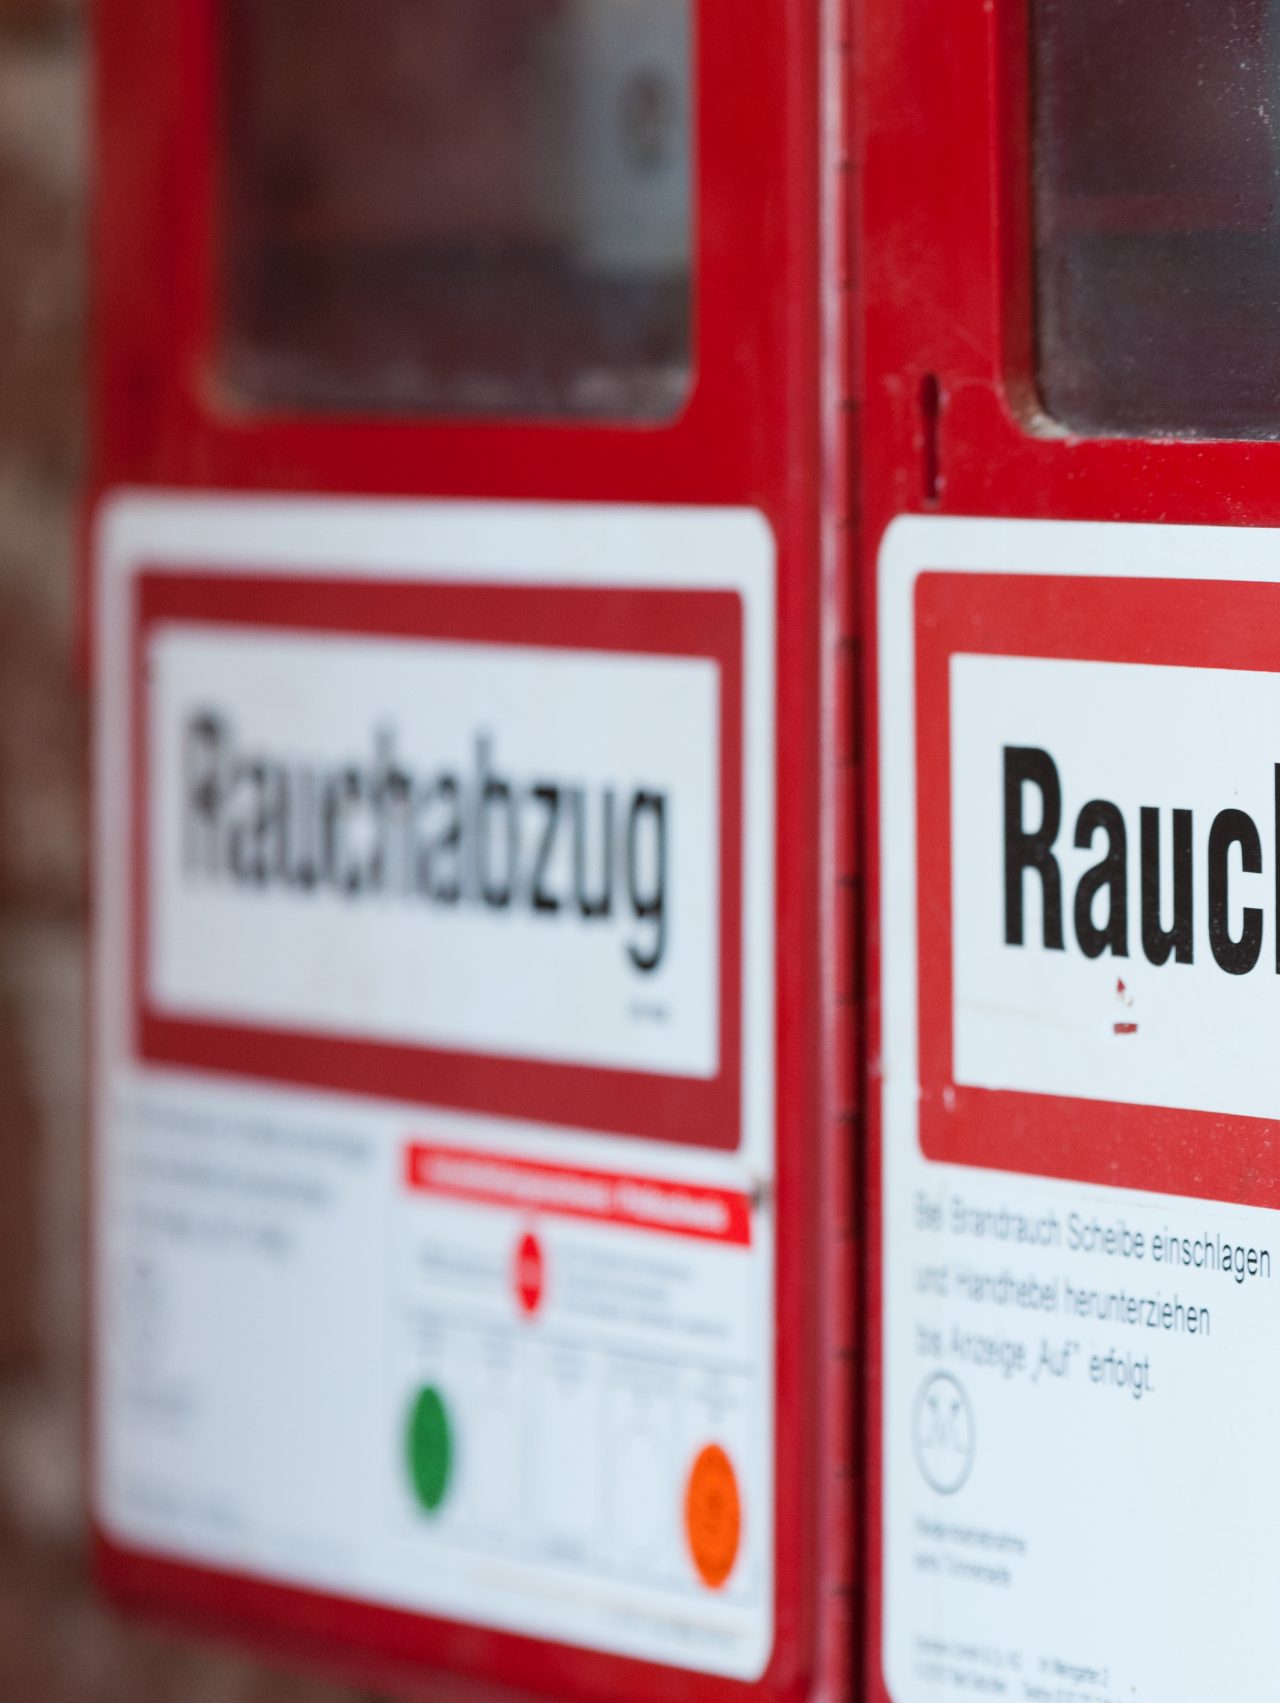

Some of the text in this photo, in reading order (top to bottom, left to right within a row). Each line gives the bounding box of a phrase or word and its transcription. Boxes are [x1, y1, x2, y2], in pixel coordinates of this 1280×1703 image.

[183, 709, 667, 972] Rauchabzug
[1067, 1212, 1146, 1259] Scheibe
[1151, 1225, 1272, 1284] einschlagen
[1064, 1279, 1211, 1336] herunterziehen
[950, 1327, 1027, 1379] Anzeige
[1089, 1347, 1155, 1399] erfolgt.
